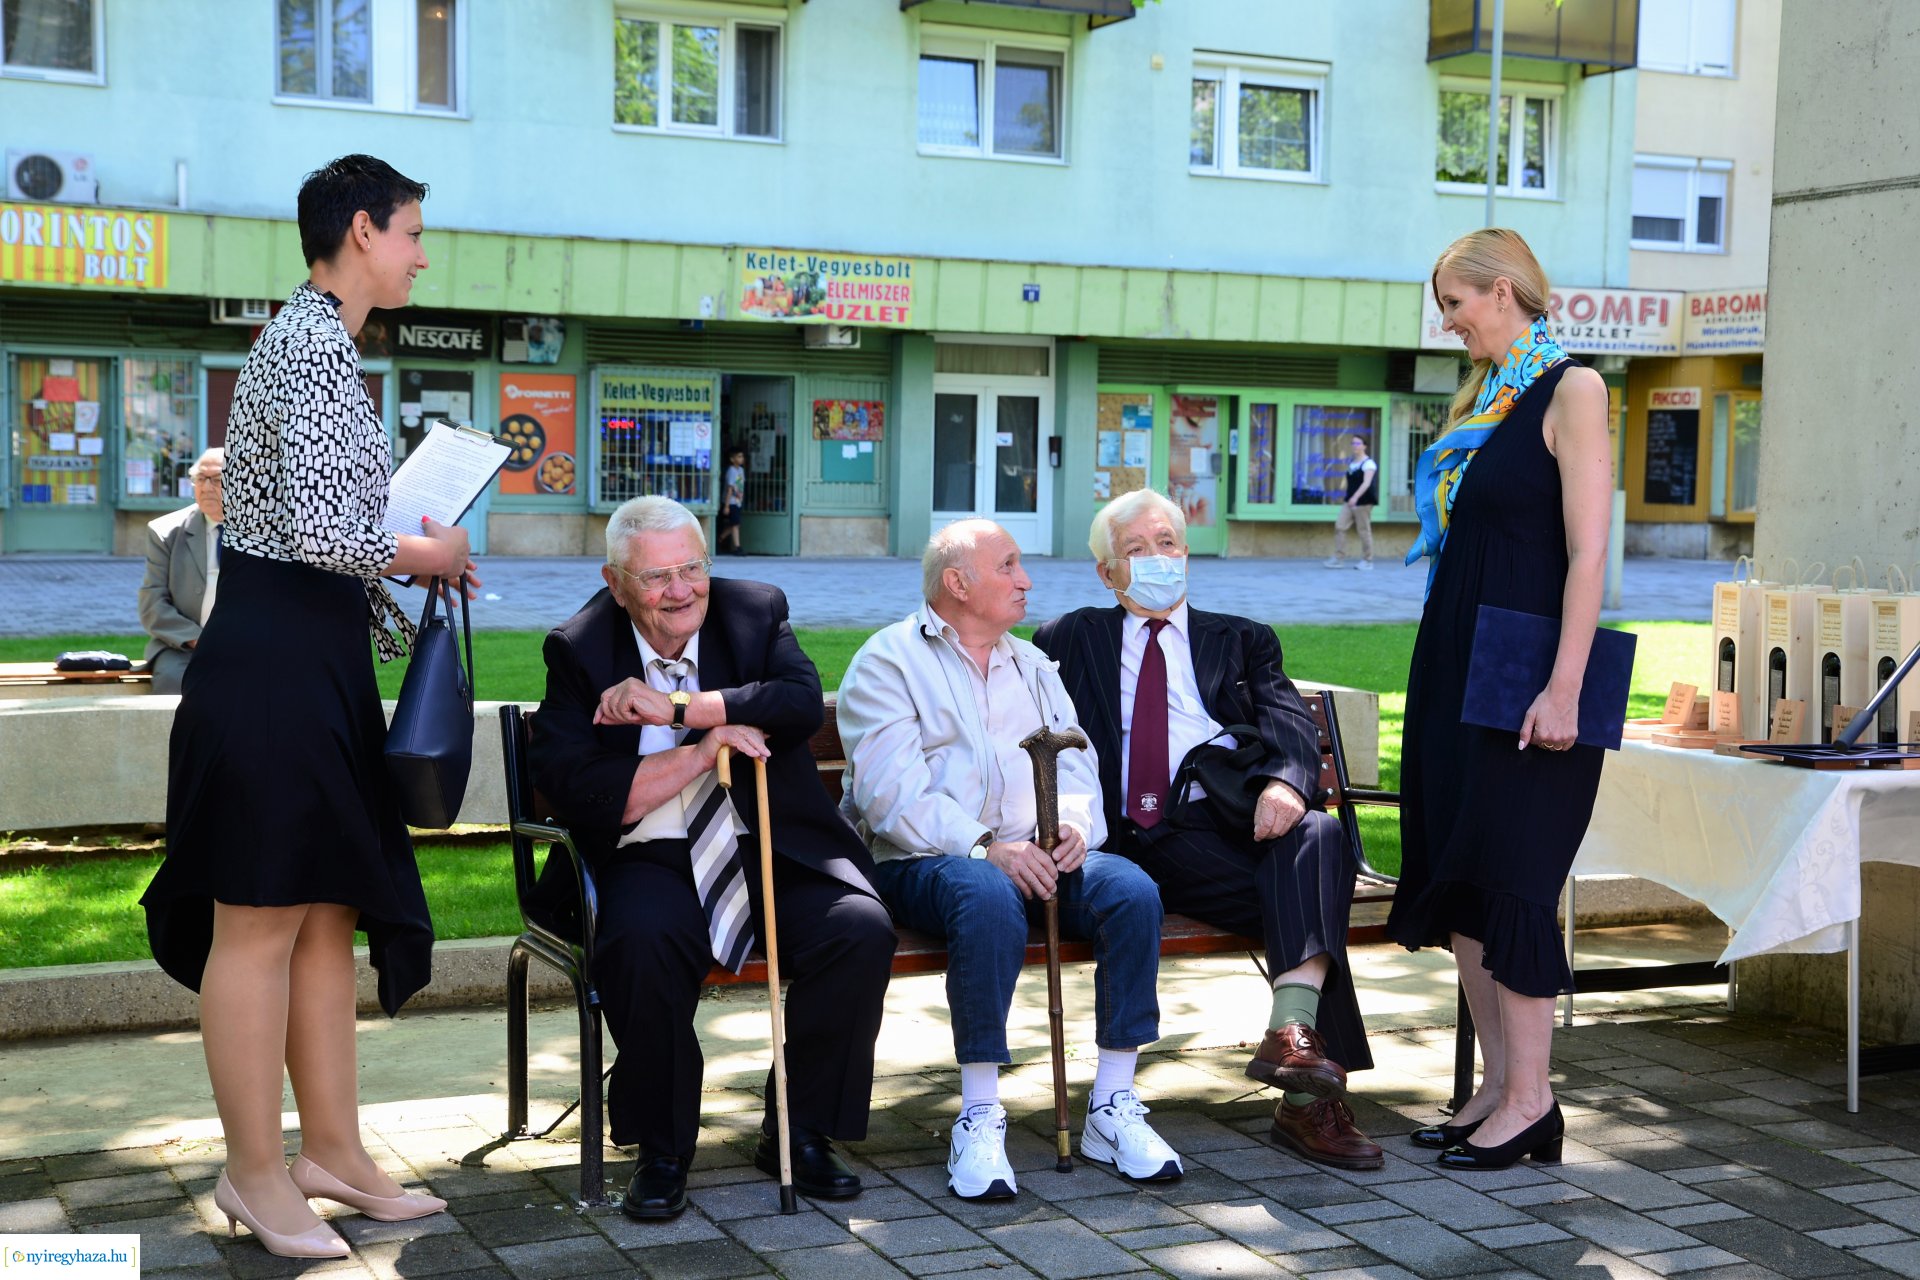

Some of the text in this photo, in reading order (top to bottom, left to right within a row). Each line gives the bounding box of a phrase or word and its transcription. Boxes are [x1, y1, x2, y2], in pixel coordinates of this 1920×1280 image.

[0, 209, 153, 253] ORINTOS
[84, 253, 149, 282] BOLT
[745, 252, 912, 278] Kelet-Vegyesbolt
[398, 324, 484, 350] NESCAFÉ
[603, 381, 711, 403] Kelet-Vegyesbolt
